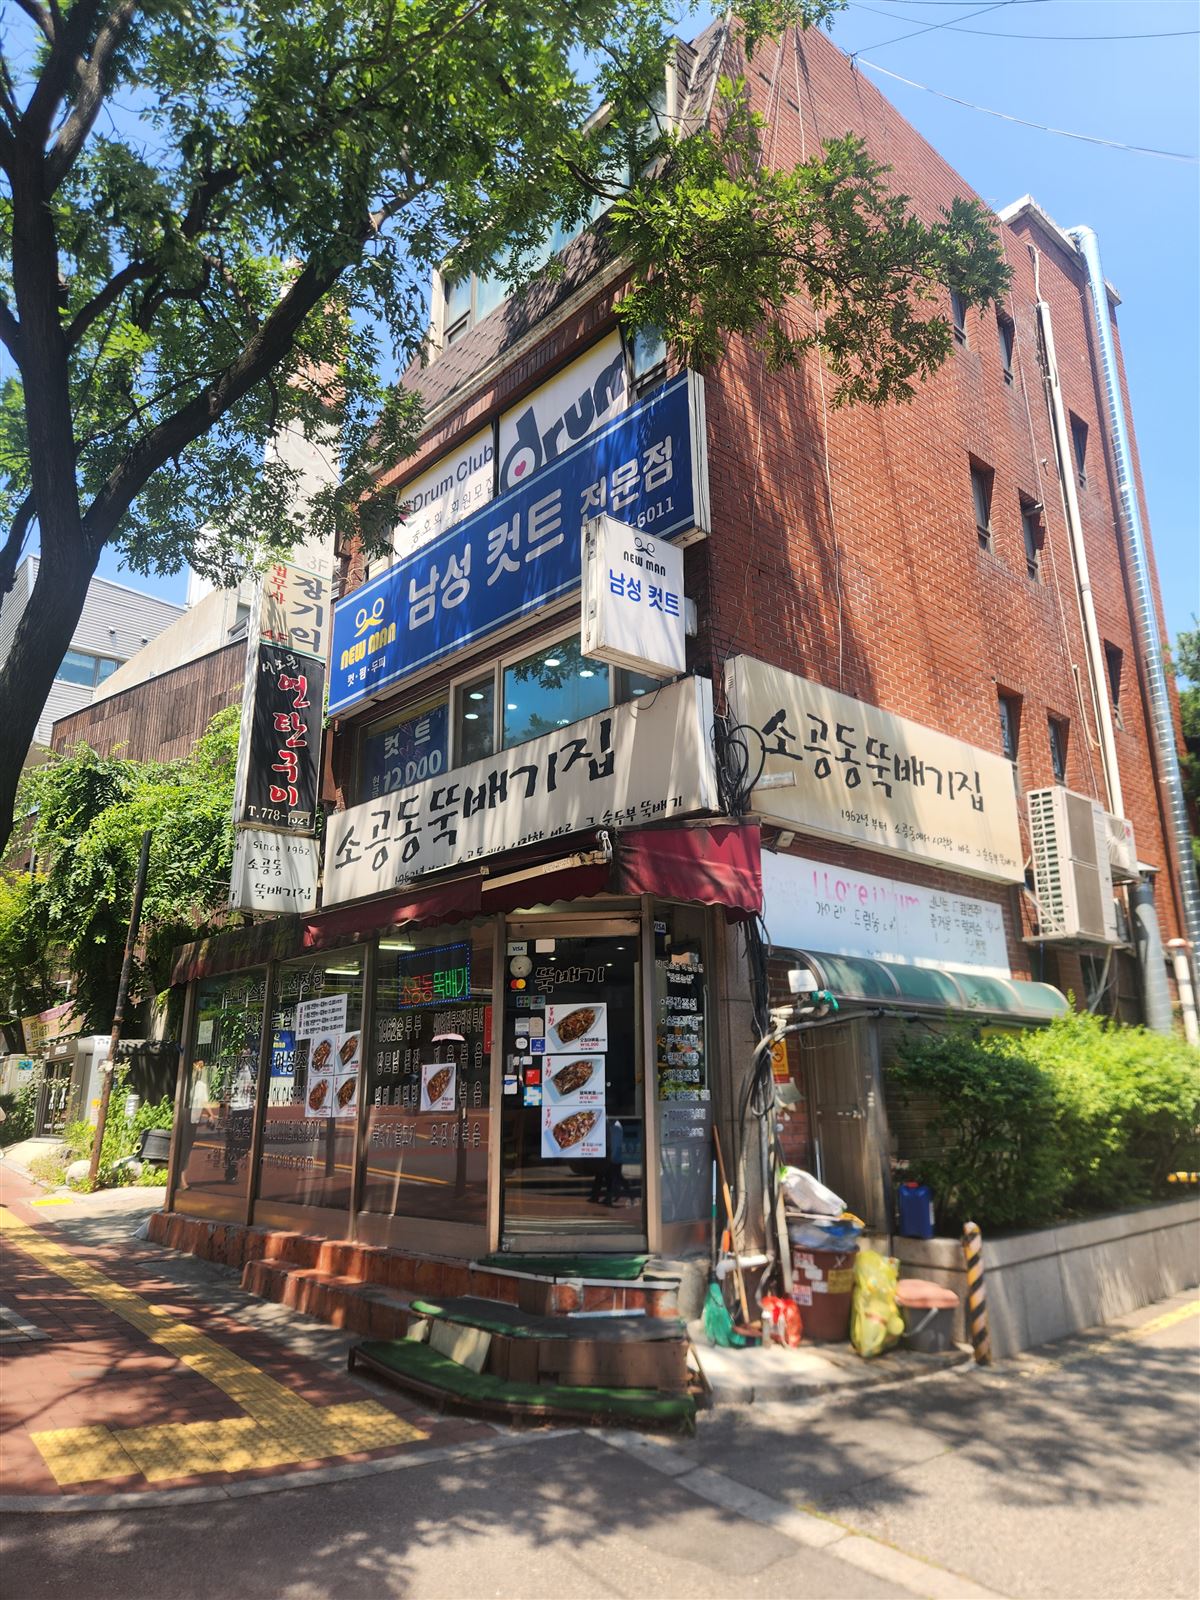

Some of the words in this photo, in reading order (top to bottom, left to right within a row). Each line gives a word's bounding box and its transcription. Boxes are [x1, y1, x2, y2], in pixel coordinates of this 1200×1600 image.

[414, 474, 453, 513] Drum
[456, 445, 494, 481] Club
[624, 504, 675, 532] -6011
[408, 543, 472, 631] 남성
[486, 488, 565, 587] 컷트
[623, 550, 643, 569] NEW
[646, 556, 667, 577] MAN
[608, 568, 641, 601] 남성
[648, 582, 680, 618] 컷트
[340, 639, 367, 671] NEW
[367, 622, 397, 655] MAN
[760, 708, 985, 812] 소공동뚝배기집
[335, 717, 615, 872] 소공동뚝배기집
[640, 795, 683, 817] 뚝배기
[253, 840, 281, 853] Since
[287, 845, 311, 856] 1962
[248, 857, 283, 877] 소공동
[254, 882, 312, 900] 뚝배기집
[535, 966, 605, 994] 뚝배기
